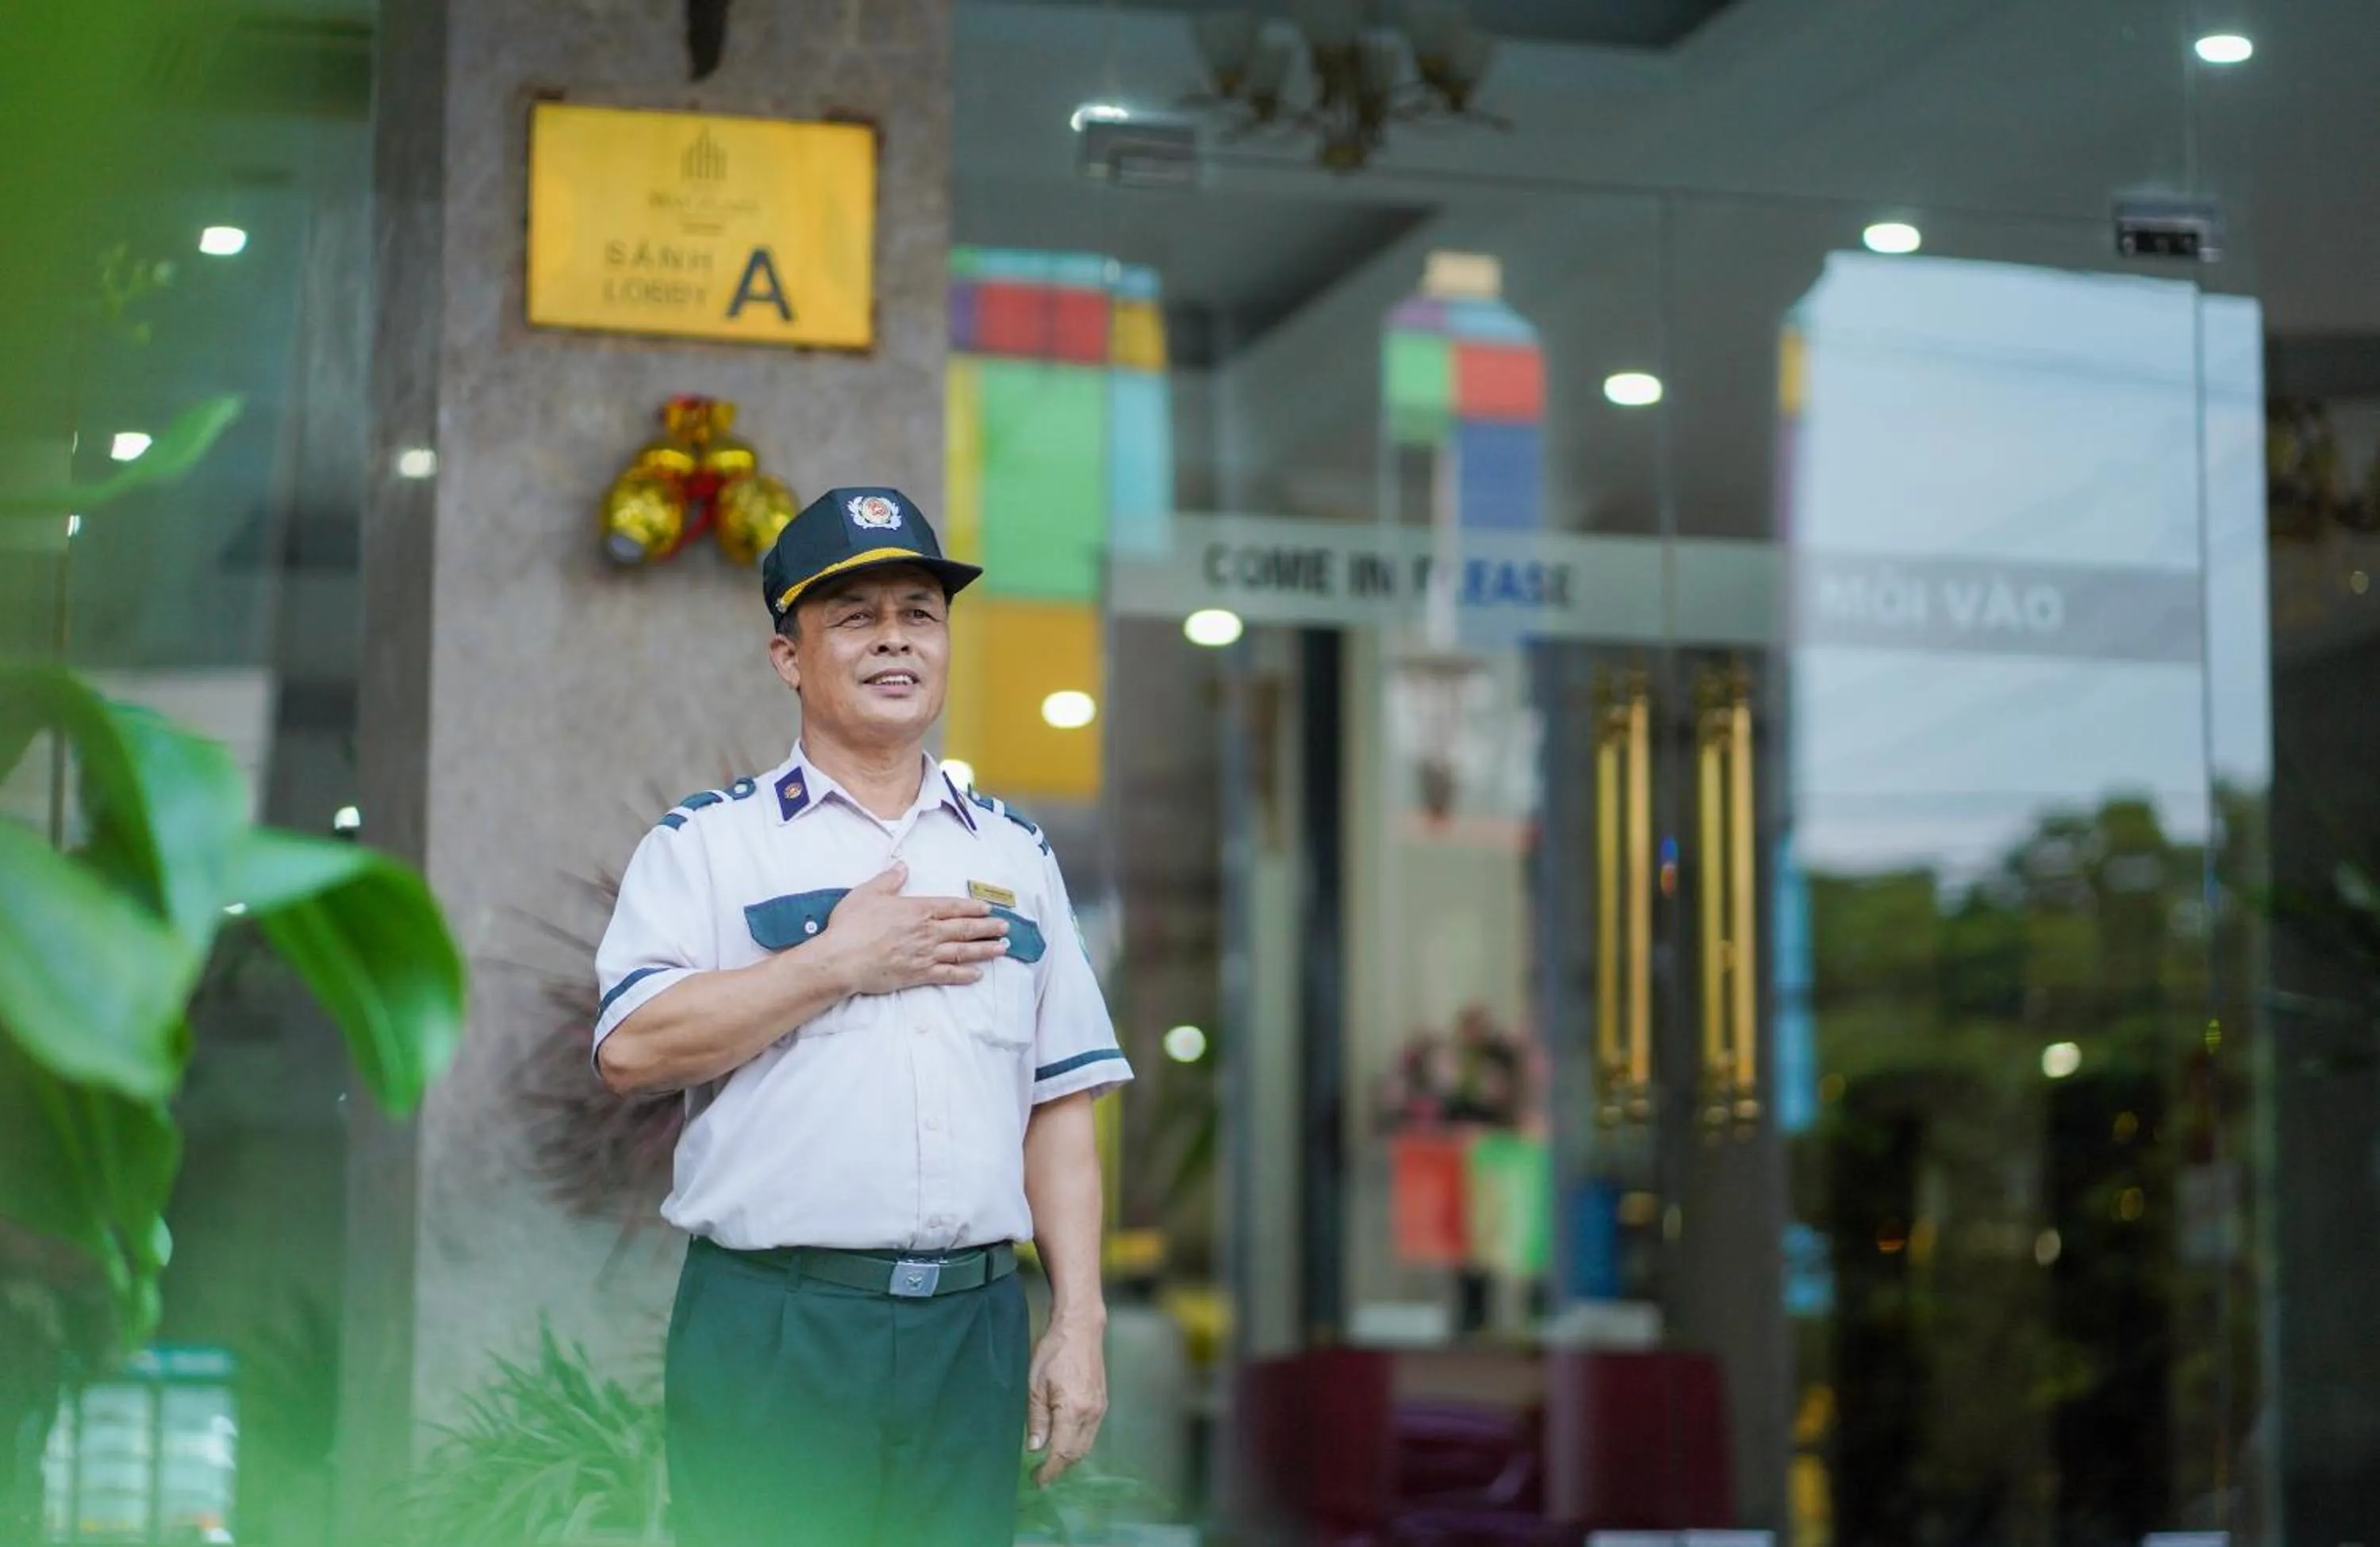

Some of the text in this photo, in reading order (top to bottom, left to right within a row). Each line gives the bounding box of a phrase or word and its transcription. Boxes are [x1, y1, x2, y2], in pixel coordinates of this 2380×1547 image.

[725, 247, 797, 322] A
[1203, 543, 1334, 595] COME
[1350, 552, 1398, 597] IN
